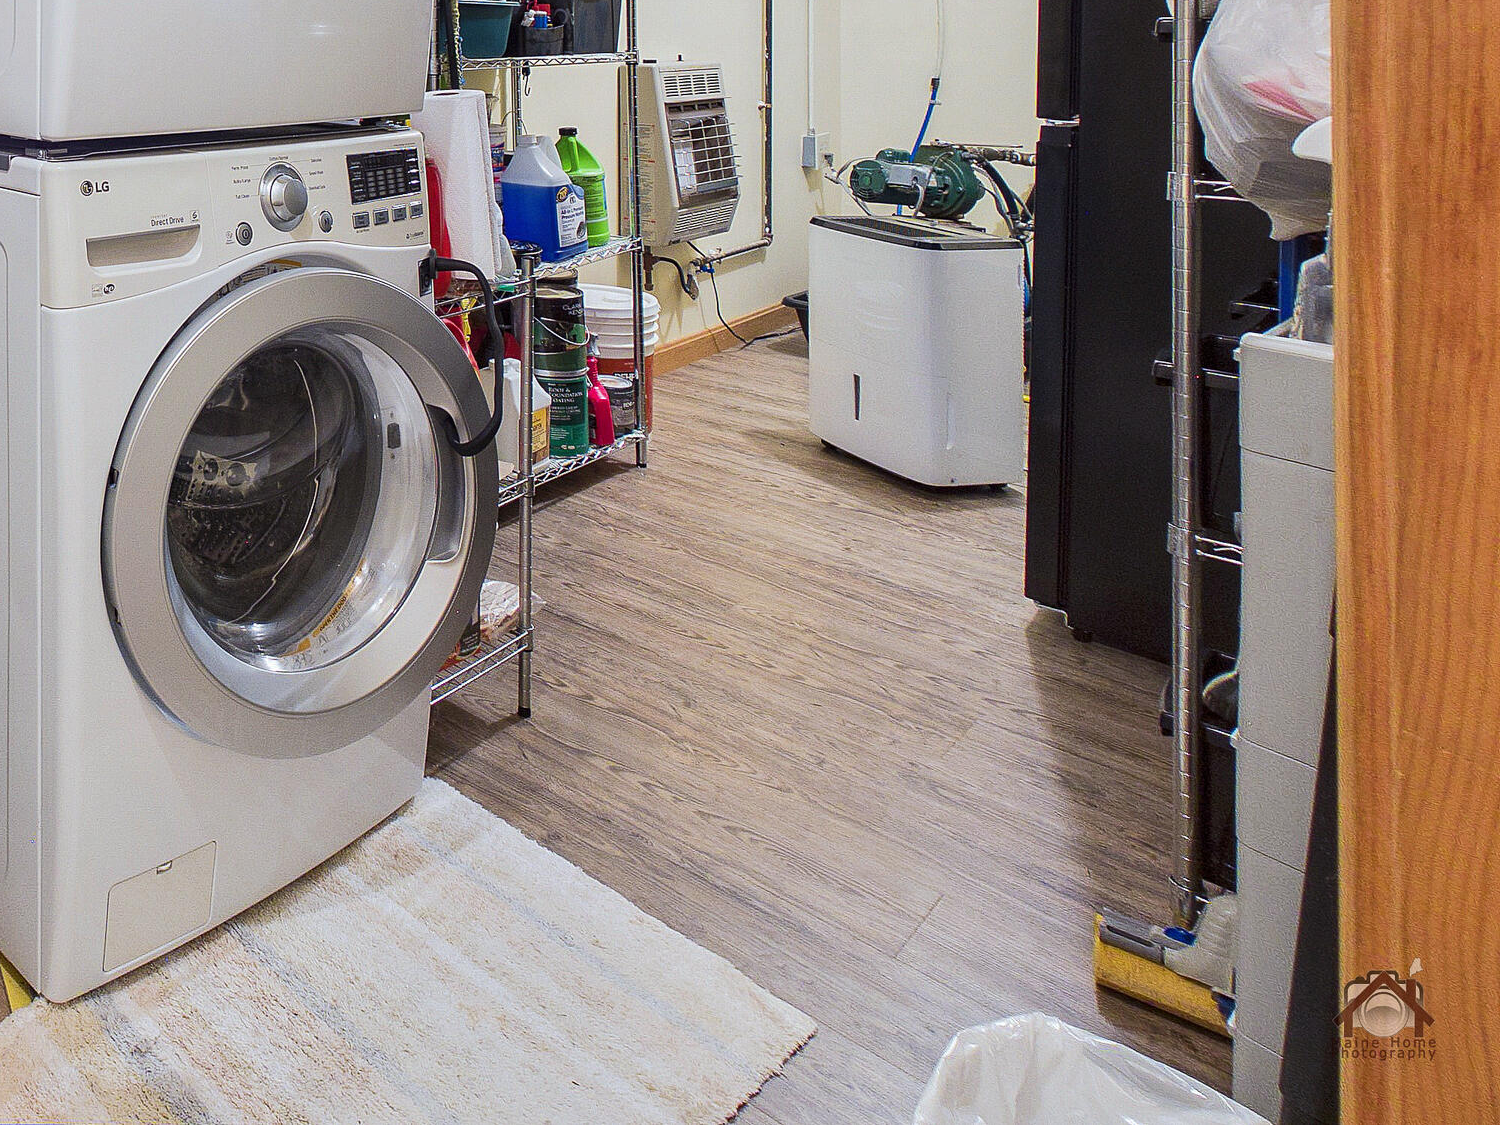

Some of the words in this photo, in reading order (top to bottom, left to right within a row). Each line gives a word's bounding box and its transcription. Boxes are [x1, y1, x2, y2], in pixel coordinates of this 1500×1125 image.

[95, 181, 110, 193] LG
[151, 218, 168, 227] Direct
[169, 216, 184, 225] Drive
